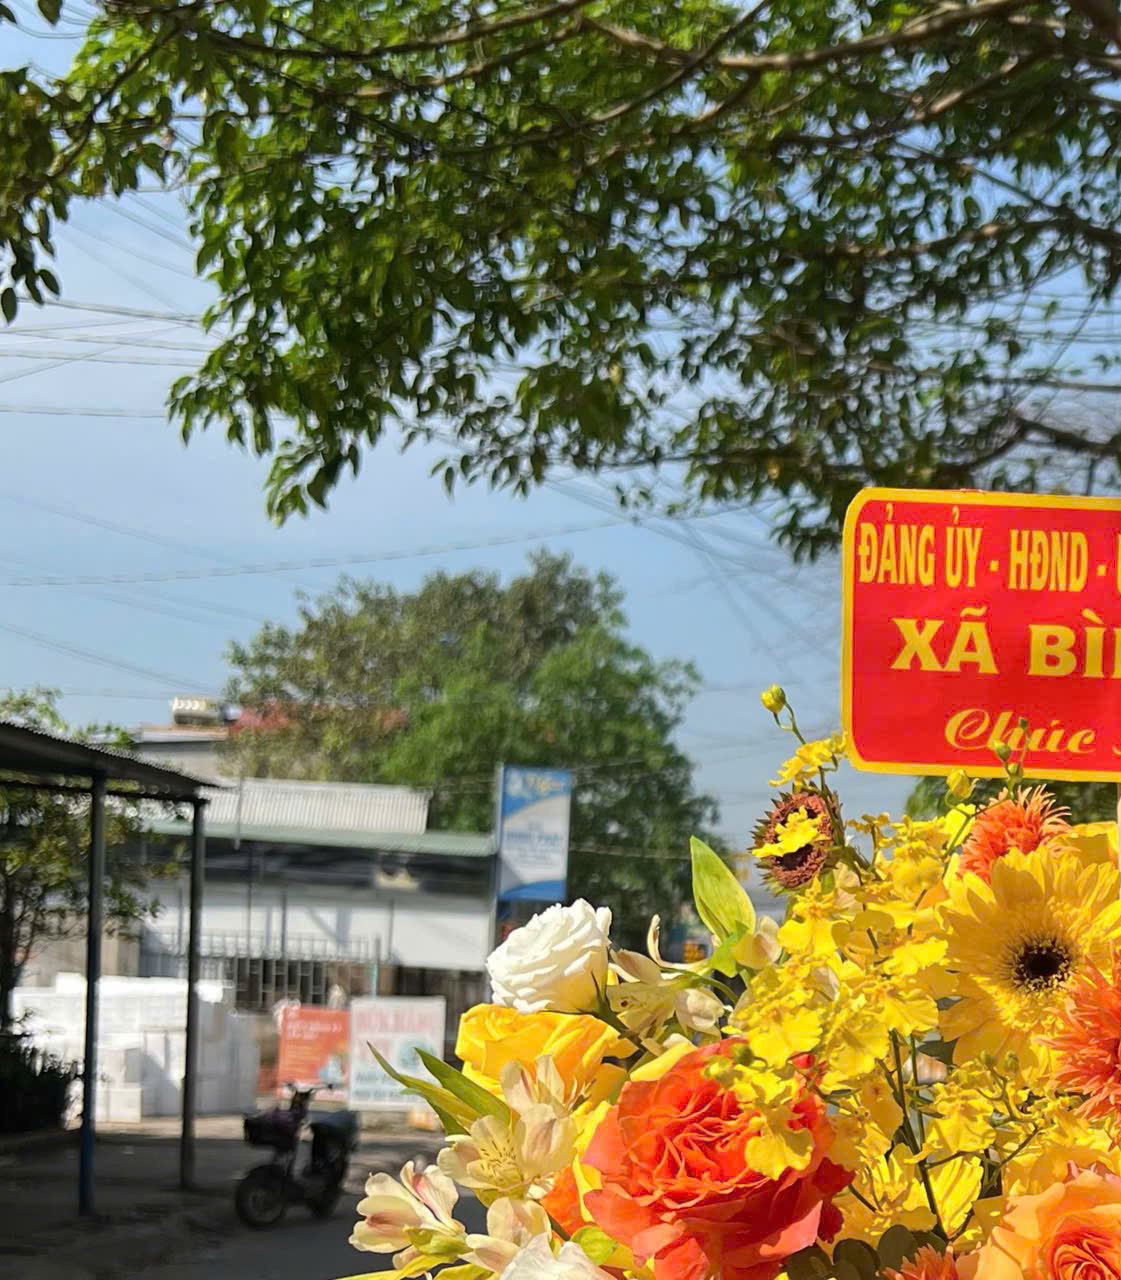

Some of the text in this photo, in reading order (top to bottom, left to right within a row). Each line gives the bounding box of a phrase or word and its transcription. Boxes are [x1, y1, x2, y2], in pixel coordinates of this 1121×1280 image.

[858, 503, 936, 586] ĐẢNG
[945, 505, 983, 588] ỦY
[1008, 529, 1089, 592] HĐND
[890, 606, 998, 675] XÃ
[944, 708, 1097, 754] Chúc
